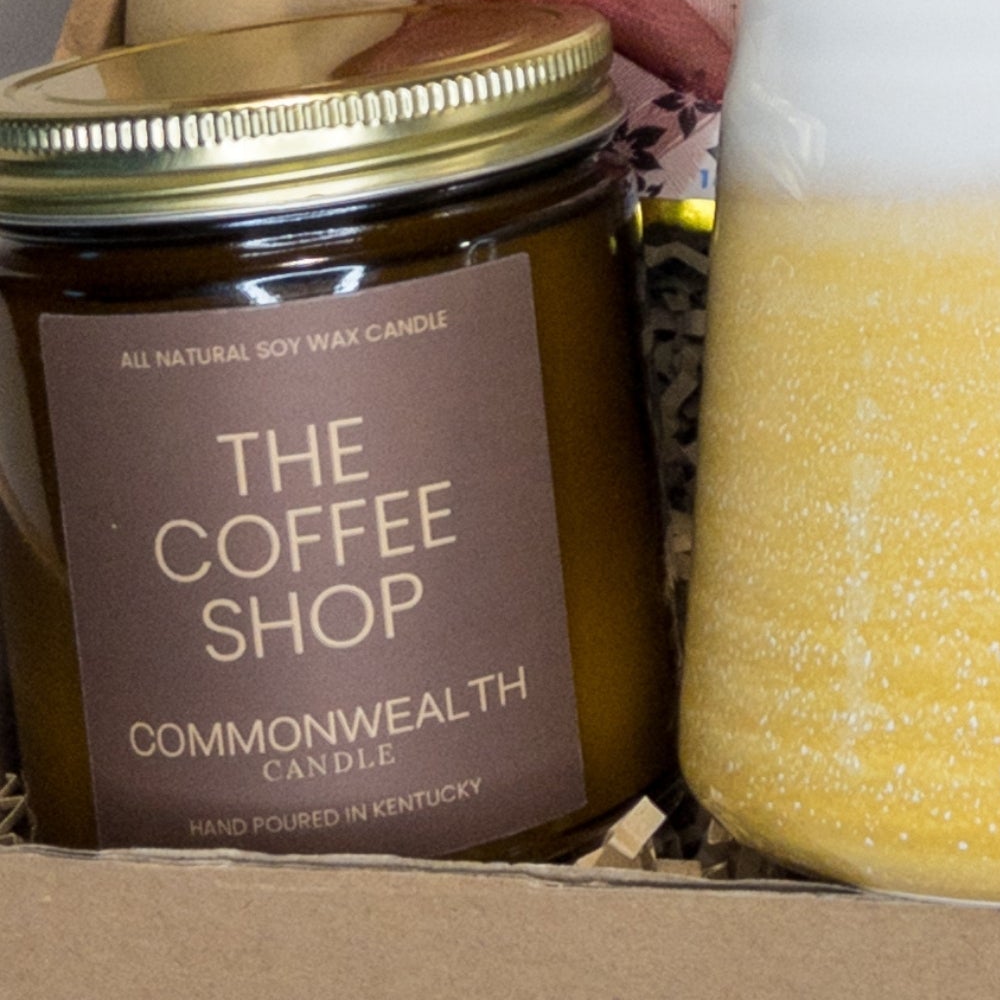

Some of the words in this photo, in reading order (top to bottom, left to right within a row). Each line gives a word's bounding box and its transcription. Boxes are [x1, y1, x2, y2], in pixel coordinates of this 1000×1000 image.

[121, 351, 150, 369] ALL
[155, 344, 249, 367] NATURAL
[256, 337, 301, 359] SOY
[306, 327, 360, 351] WAX
[364, 310, 448, 343] CANDLE
[217, 416, 369, 496] THE
[154, 480, 457, 583] COFFEE
[202, 571, 425, 662] SHOP
[129, 666, 528, 758] COMMONWEALTH
[262, 742, 396, 783] CANDLE
[190, 818, 248, 838] HAND
[253, 808, 340, 835] POURED
[345, 805, 368, 823] IN
[373, 777, 482, 819] KENTUCKY
